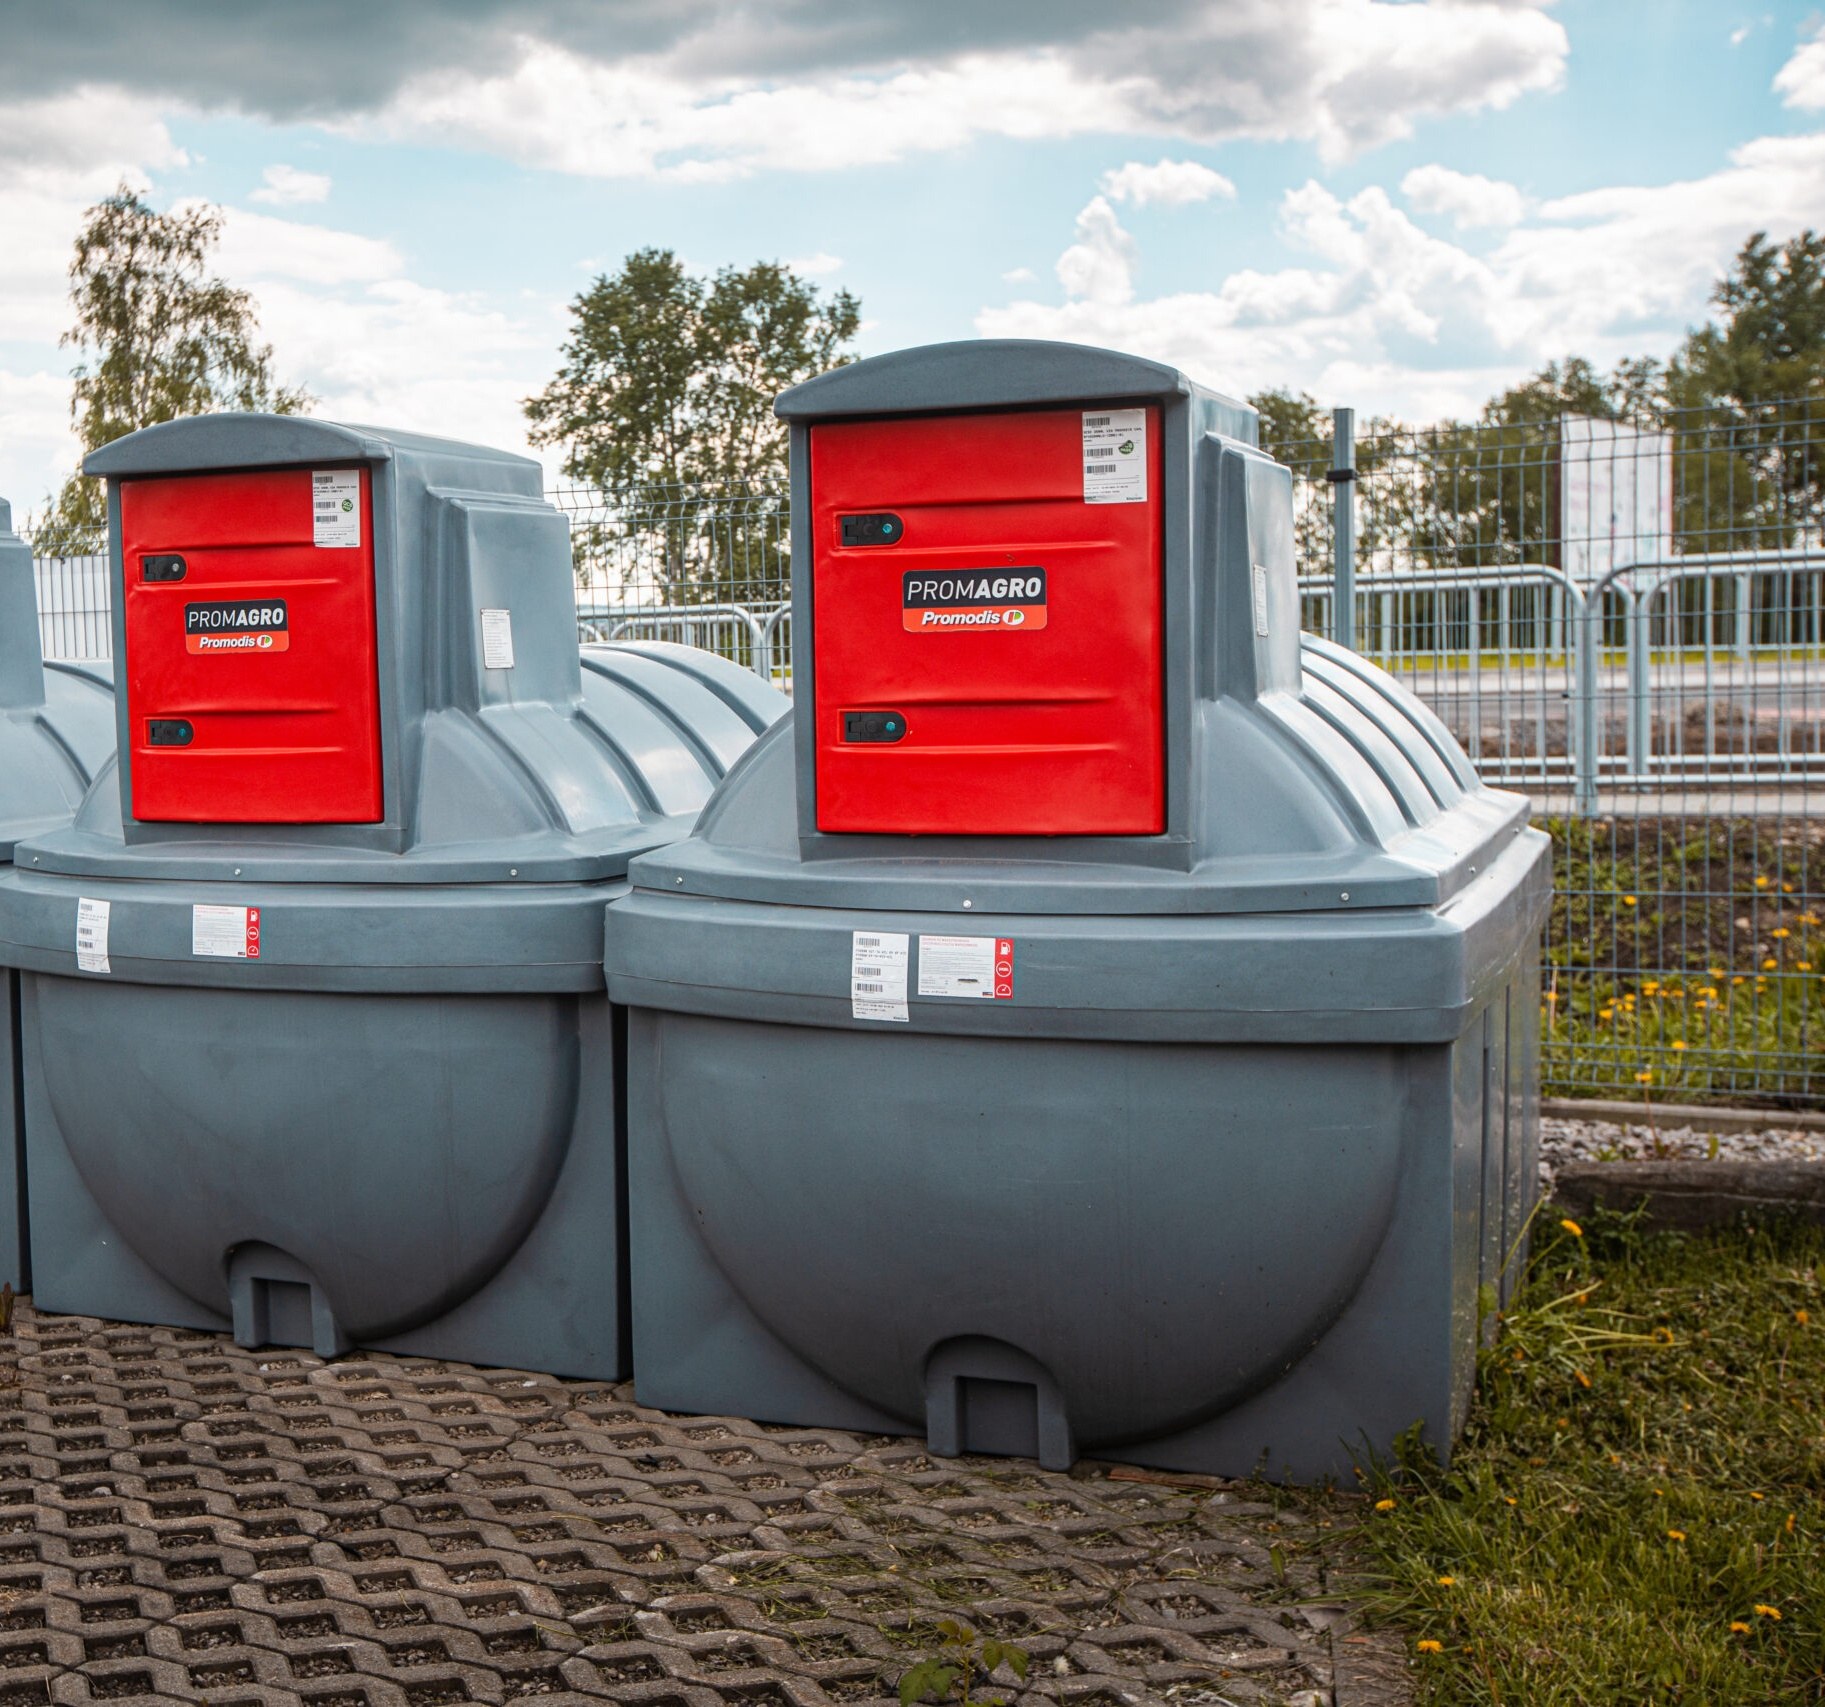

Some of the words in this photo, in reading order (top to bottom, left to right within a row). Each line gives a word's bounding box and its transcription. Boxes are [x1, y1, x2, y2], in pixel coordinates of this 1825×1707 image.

[907, 577, 1042, 601] PROMAGRO
[188, 608, 284, 628] PROMAGRO
[921, 610, 1001, 625] Promodis
[199, 635, 255, 649] Promodis
